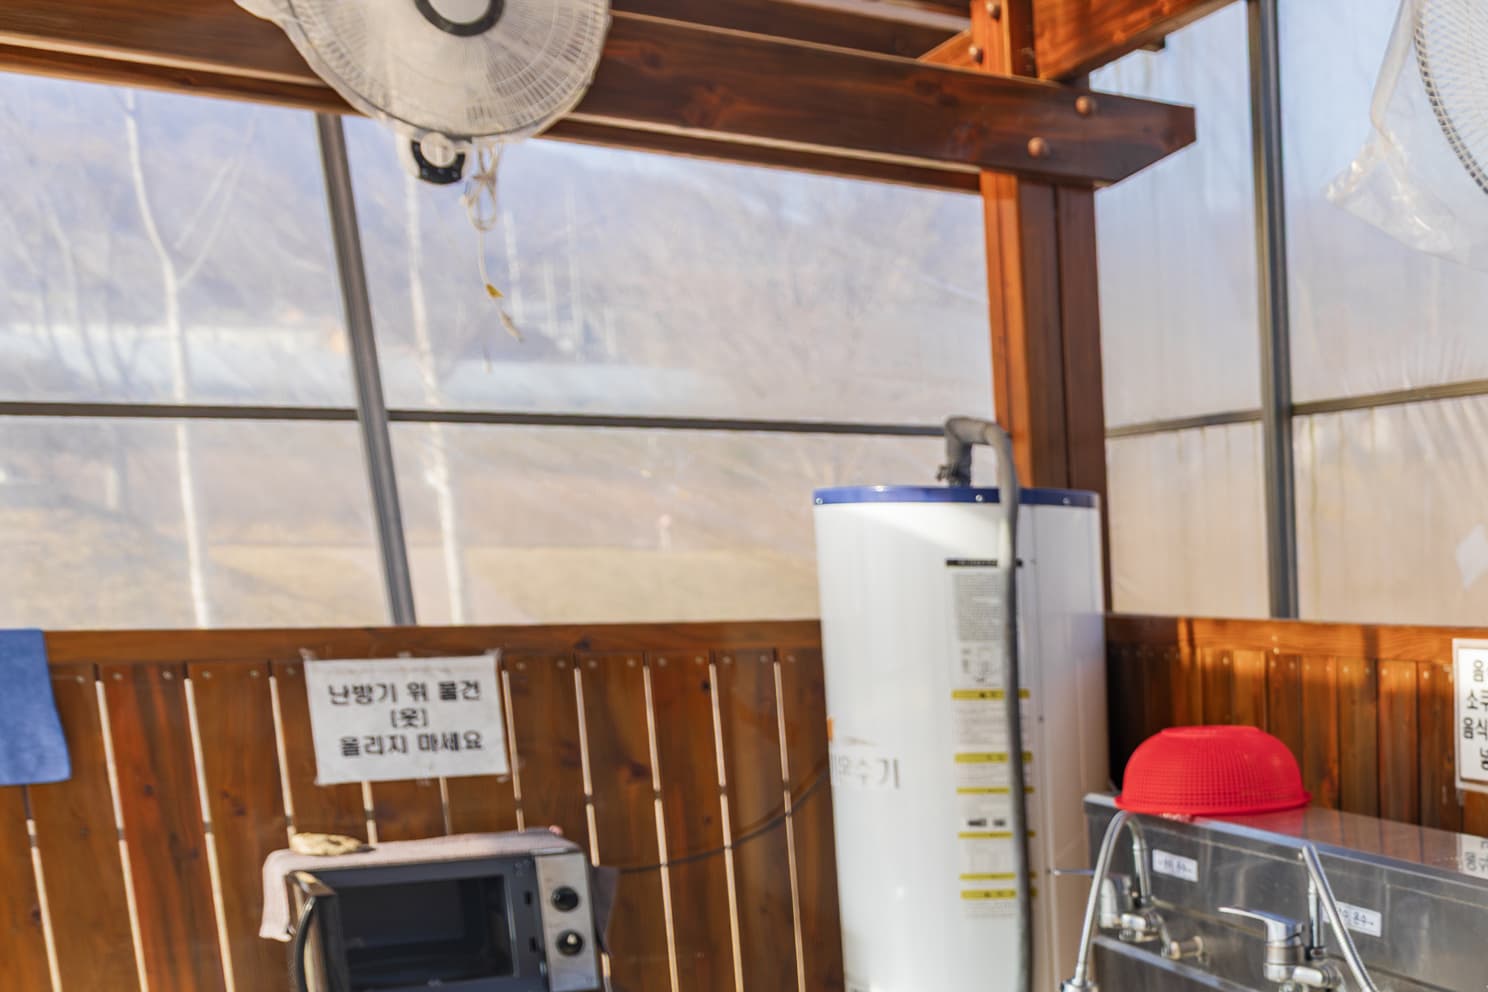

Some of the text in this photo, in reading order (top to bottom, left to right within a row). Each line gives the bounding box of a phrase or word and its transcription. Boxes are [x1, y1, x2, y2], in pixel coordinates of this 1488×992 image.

[329, 680, 481, 706] 난방기 위 물건
[341, 731, 482, 757] 올리지 마세요
